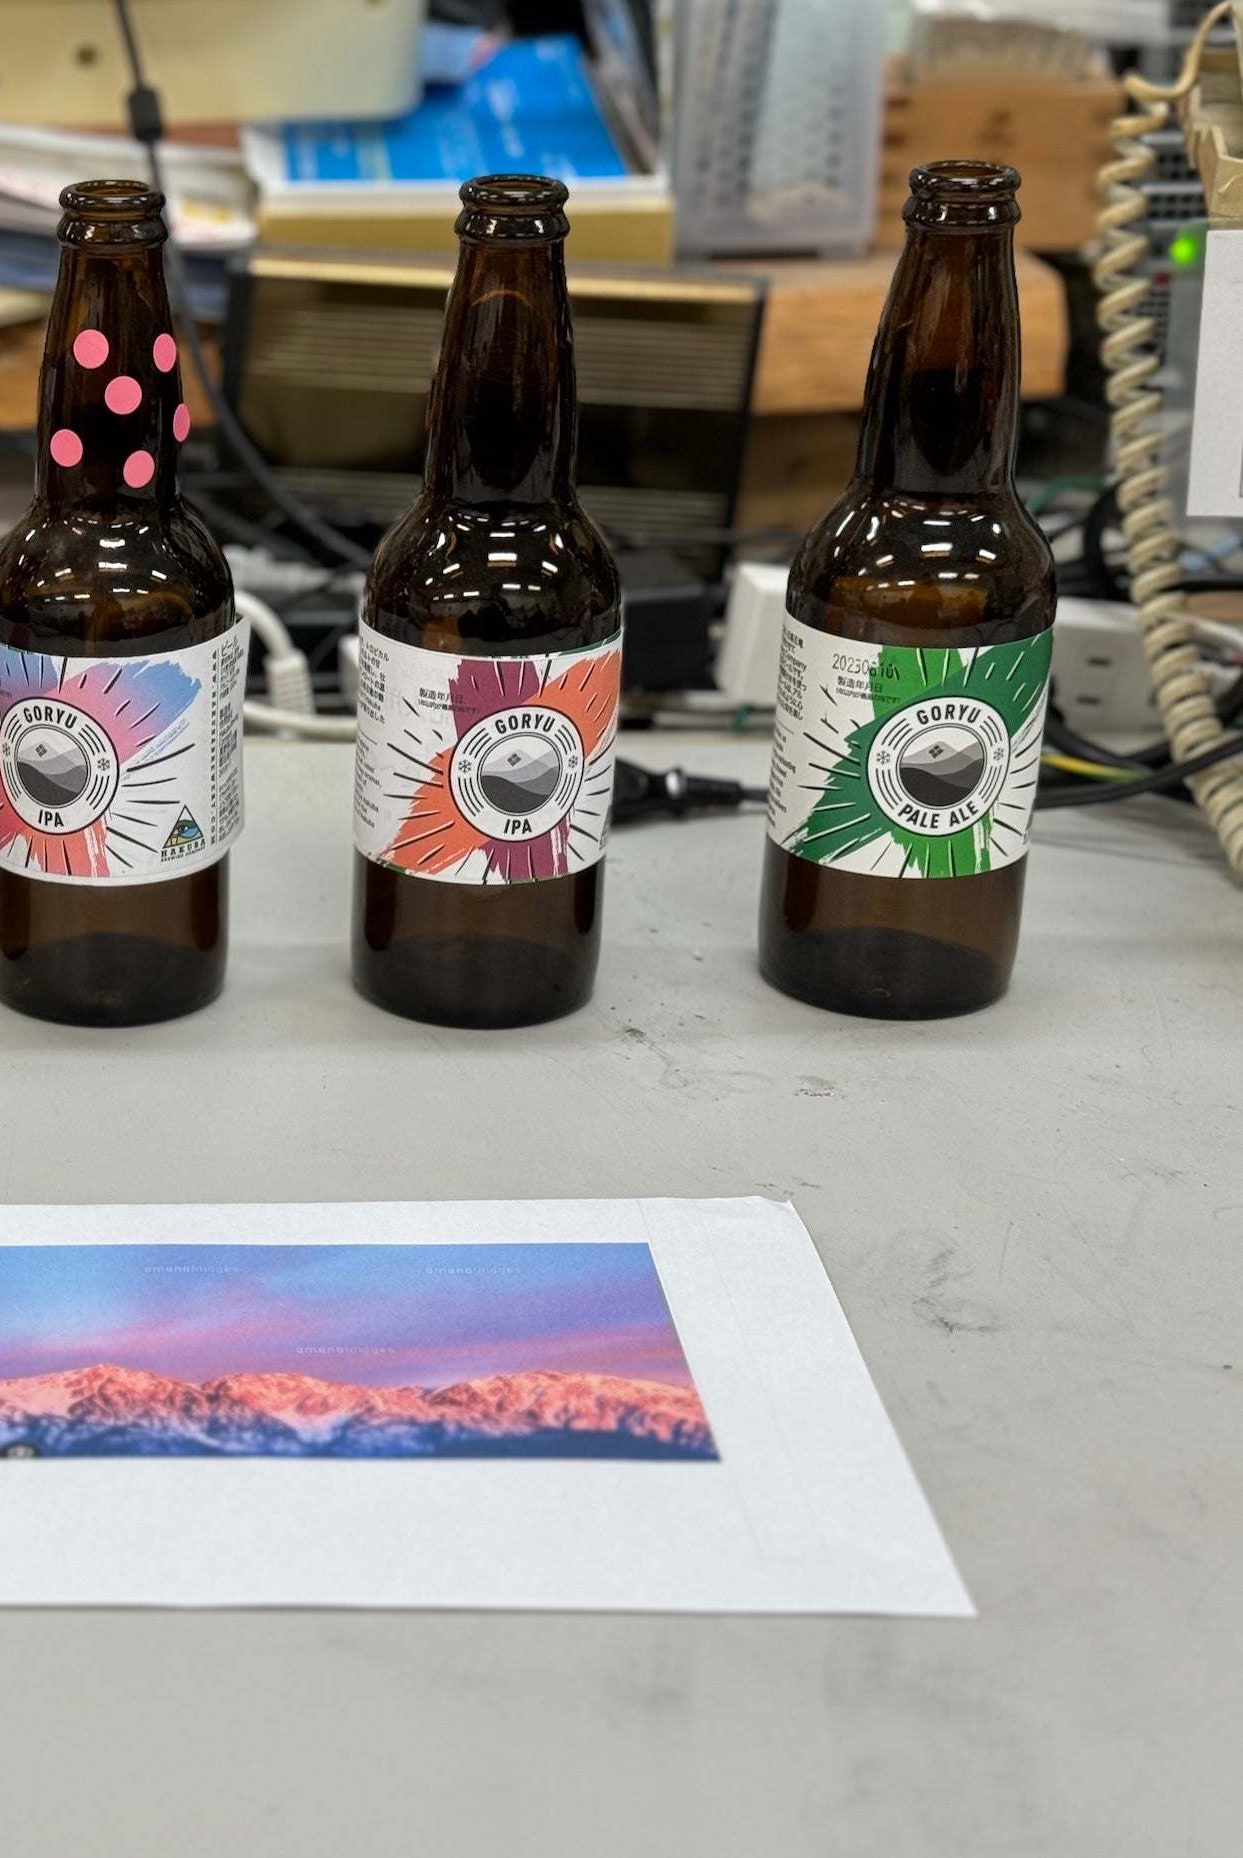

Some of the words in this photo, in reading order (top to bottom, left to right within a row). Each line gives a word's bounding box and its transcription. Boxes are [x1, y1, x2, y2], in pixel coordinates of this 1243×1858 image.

[23, 706, 79, 728] GORYU
[495, 714, 556, 734] GORYU
[916, 704, 982, 725] GORYU
[38, 810, 65, 828] IPA
[898, 804, 940, 830] PALE
[949, 801, 979, 827] ALE
[503, 818, 533, 835] IPA
[160, 838, 206, 857] HAKUBA
